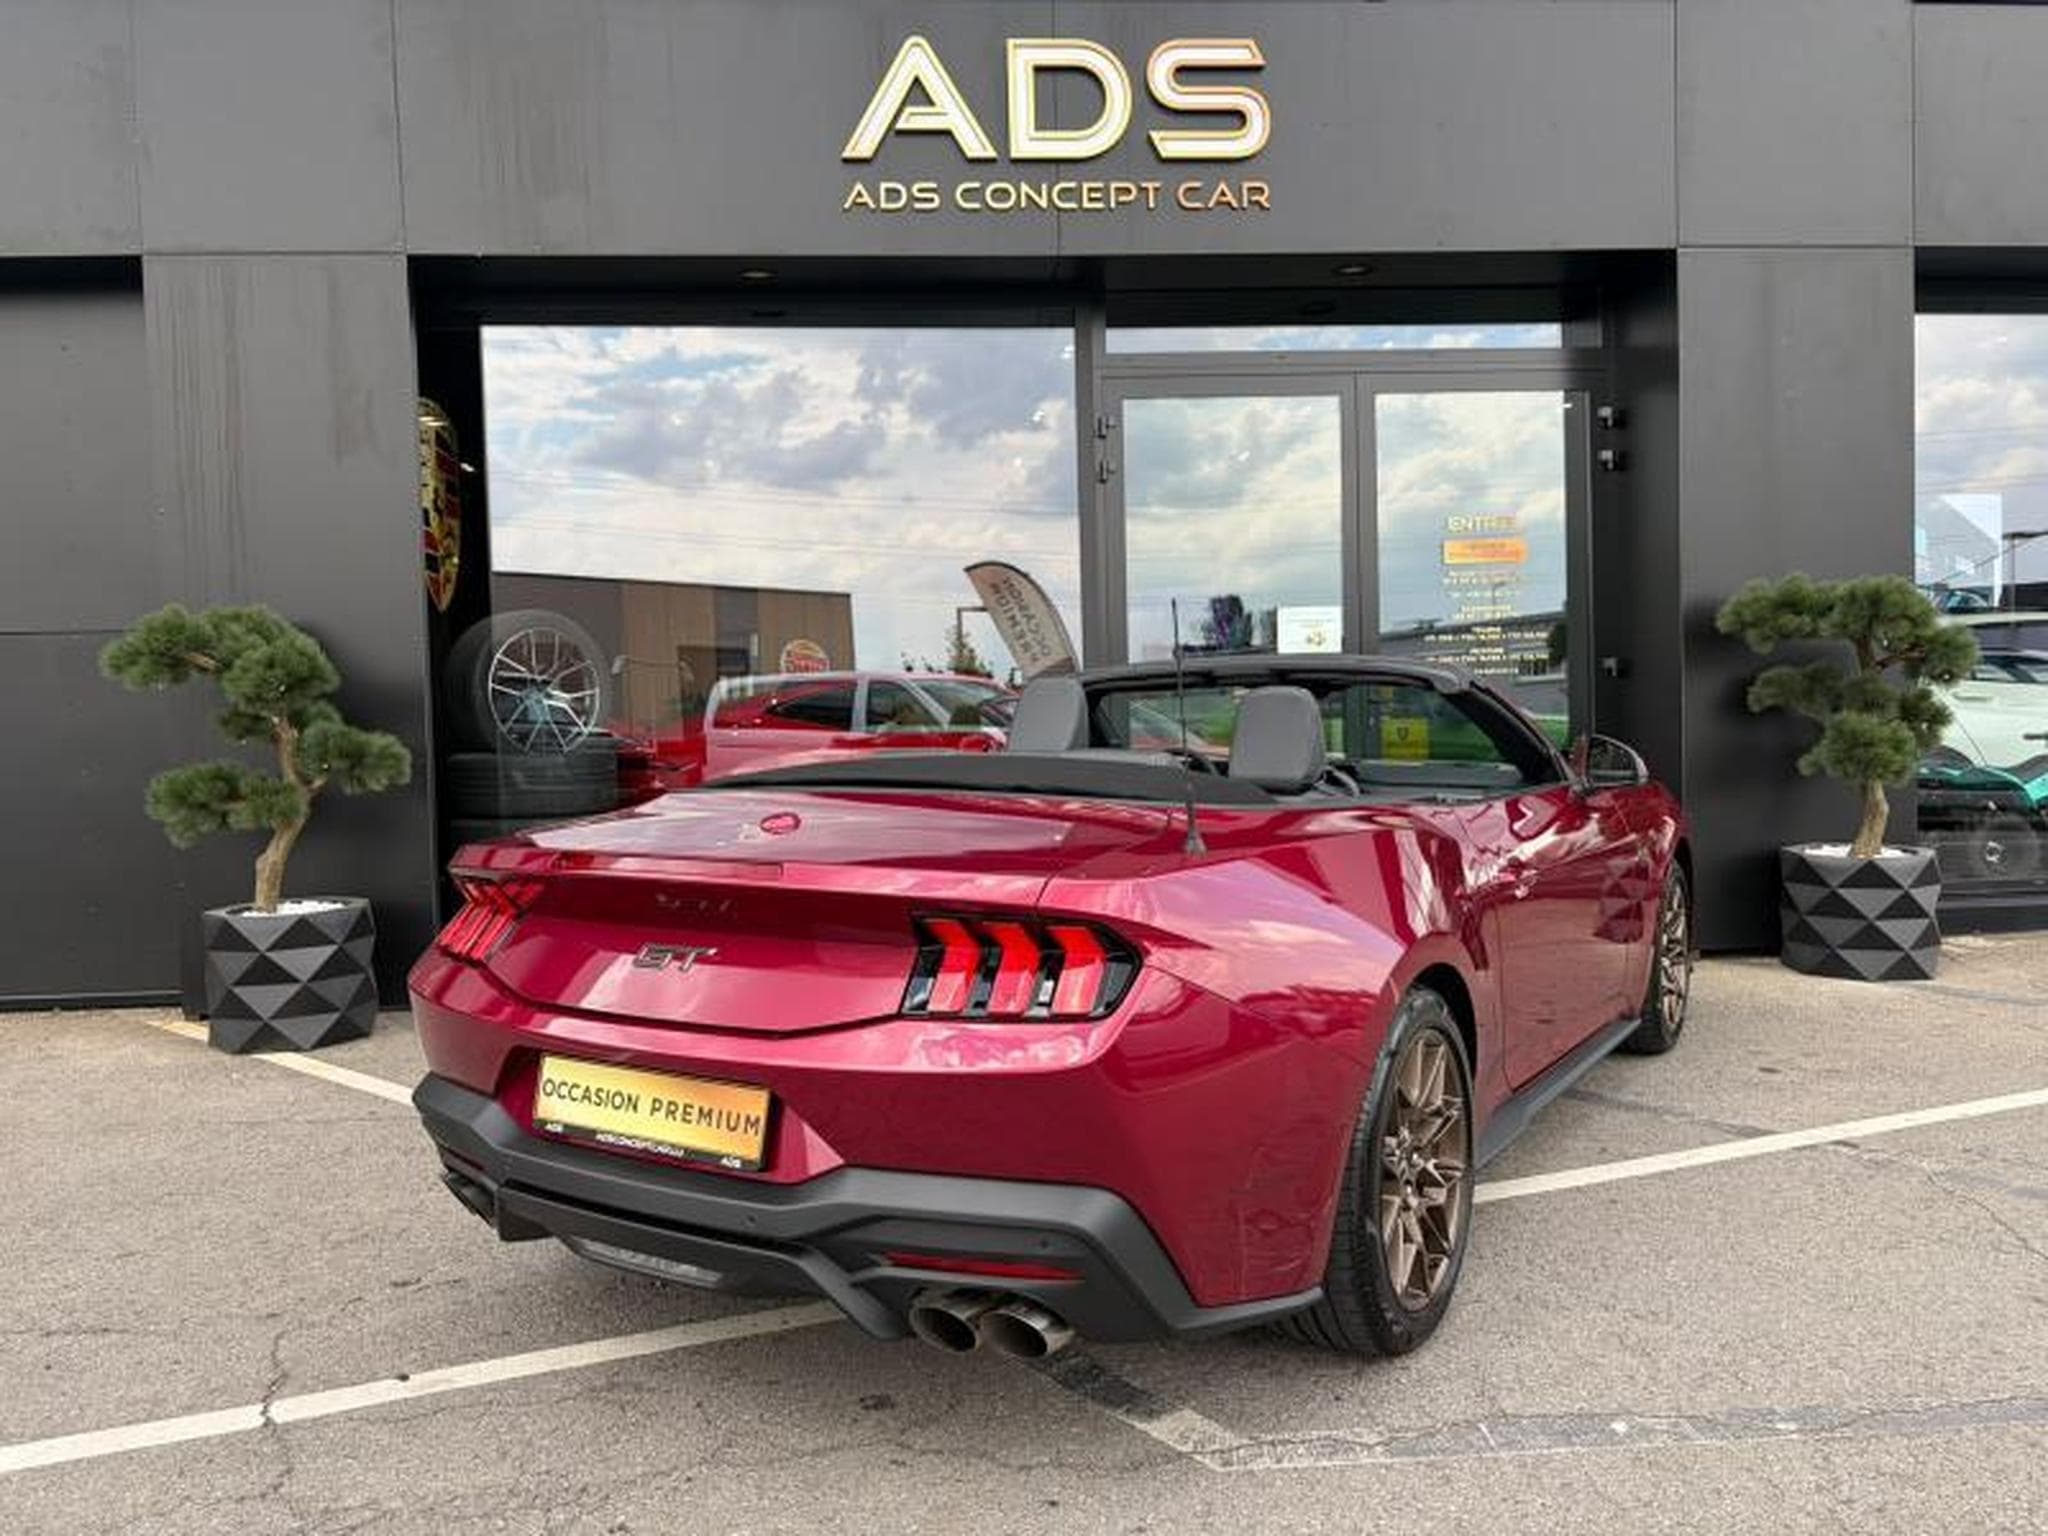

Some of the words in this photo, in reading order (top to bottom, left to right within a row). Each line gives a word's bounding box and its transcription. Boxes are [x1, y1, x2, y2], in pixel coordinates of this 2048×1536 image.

[841, 35, 1271, 161] ADS
[843, 181, 940, 210] ADS
[955, 181, 1162, 210] CONCEPT
[1175, 181, 1271, 210] CAR
[632, 943, 718, 972] GT
[541, 1078, 640, 1114] OCCASION
[649, 1097, 761, 1136] PREMIUM
